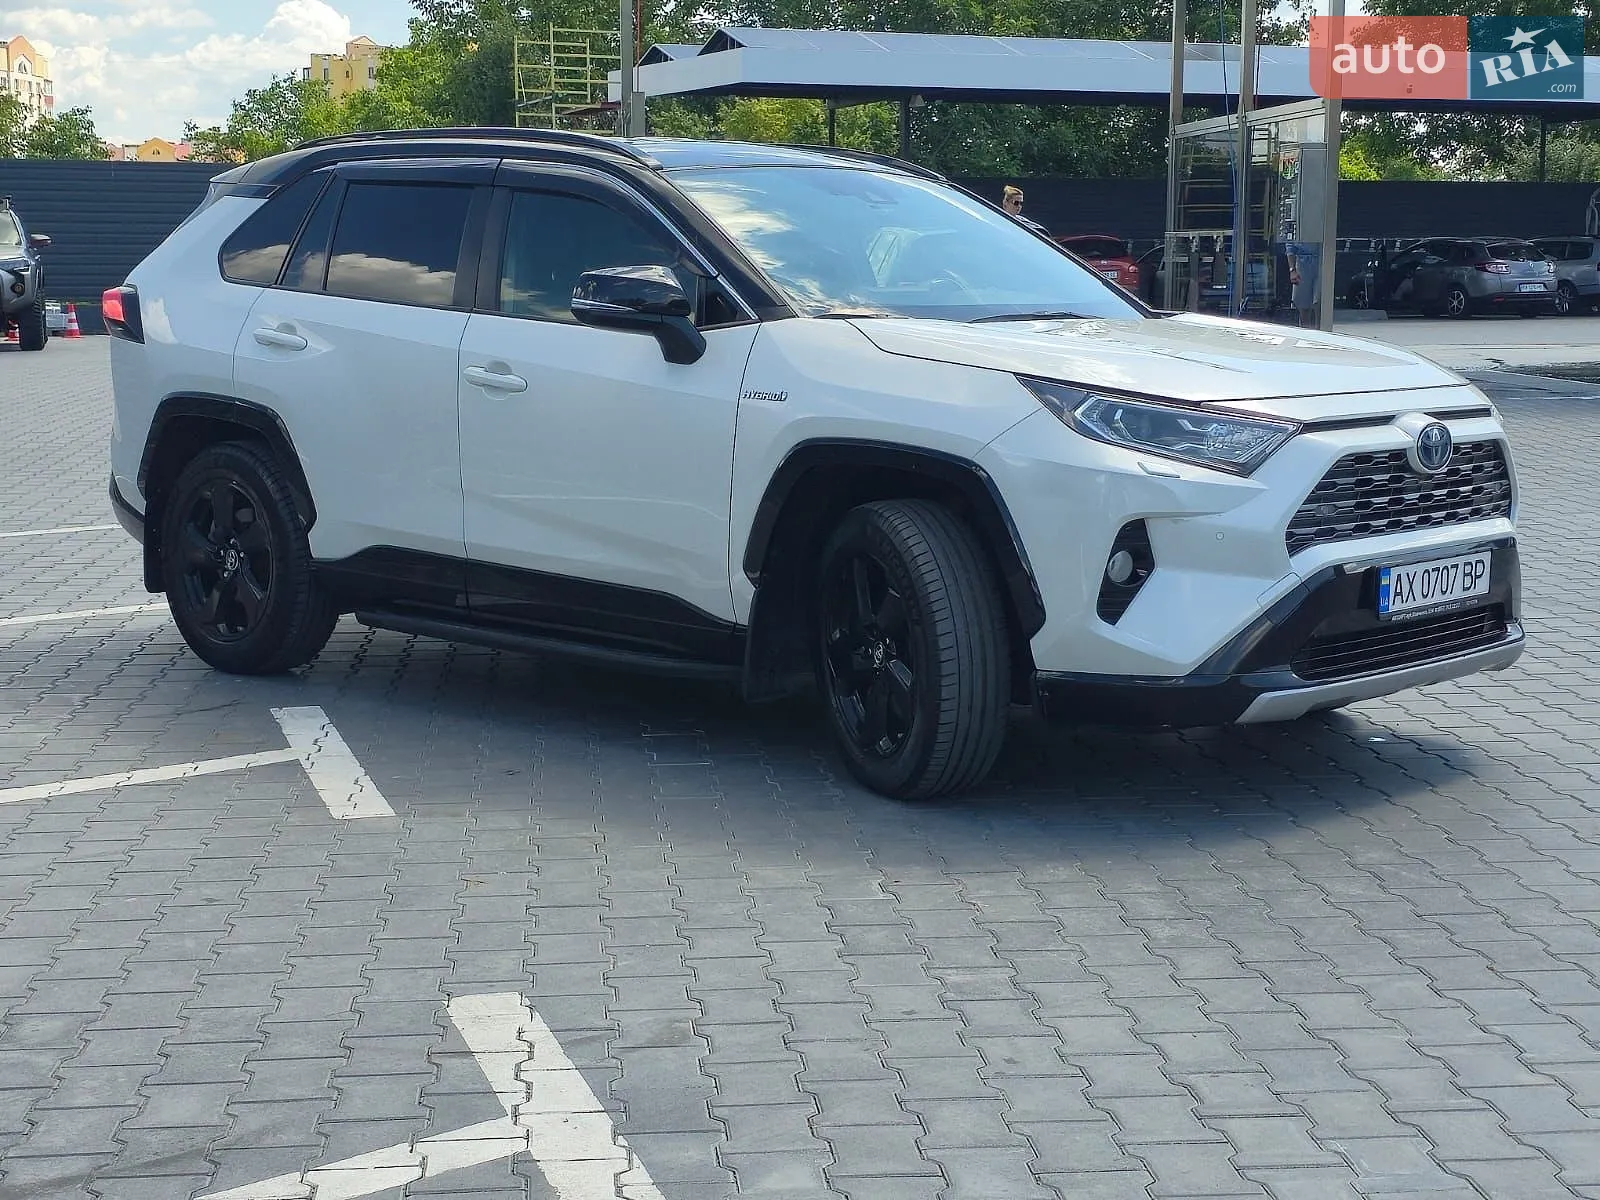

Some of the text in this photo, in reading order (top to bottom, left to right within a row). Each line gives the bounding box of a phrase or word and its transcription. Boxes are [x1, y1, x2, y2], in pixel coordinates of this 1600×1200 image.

[742, 390, 788, 402] HYBRID
[1392, 559, 1486, 606] AX 0707 BP
[1380, 596, 1389, 607] UA
